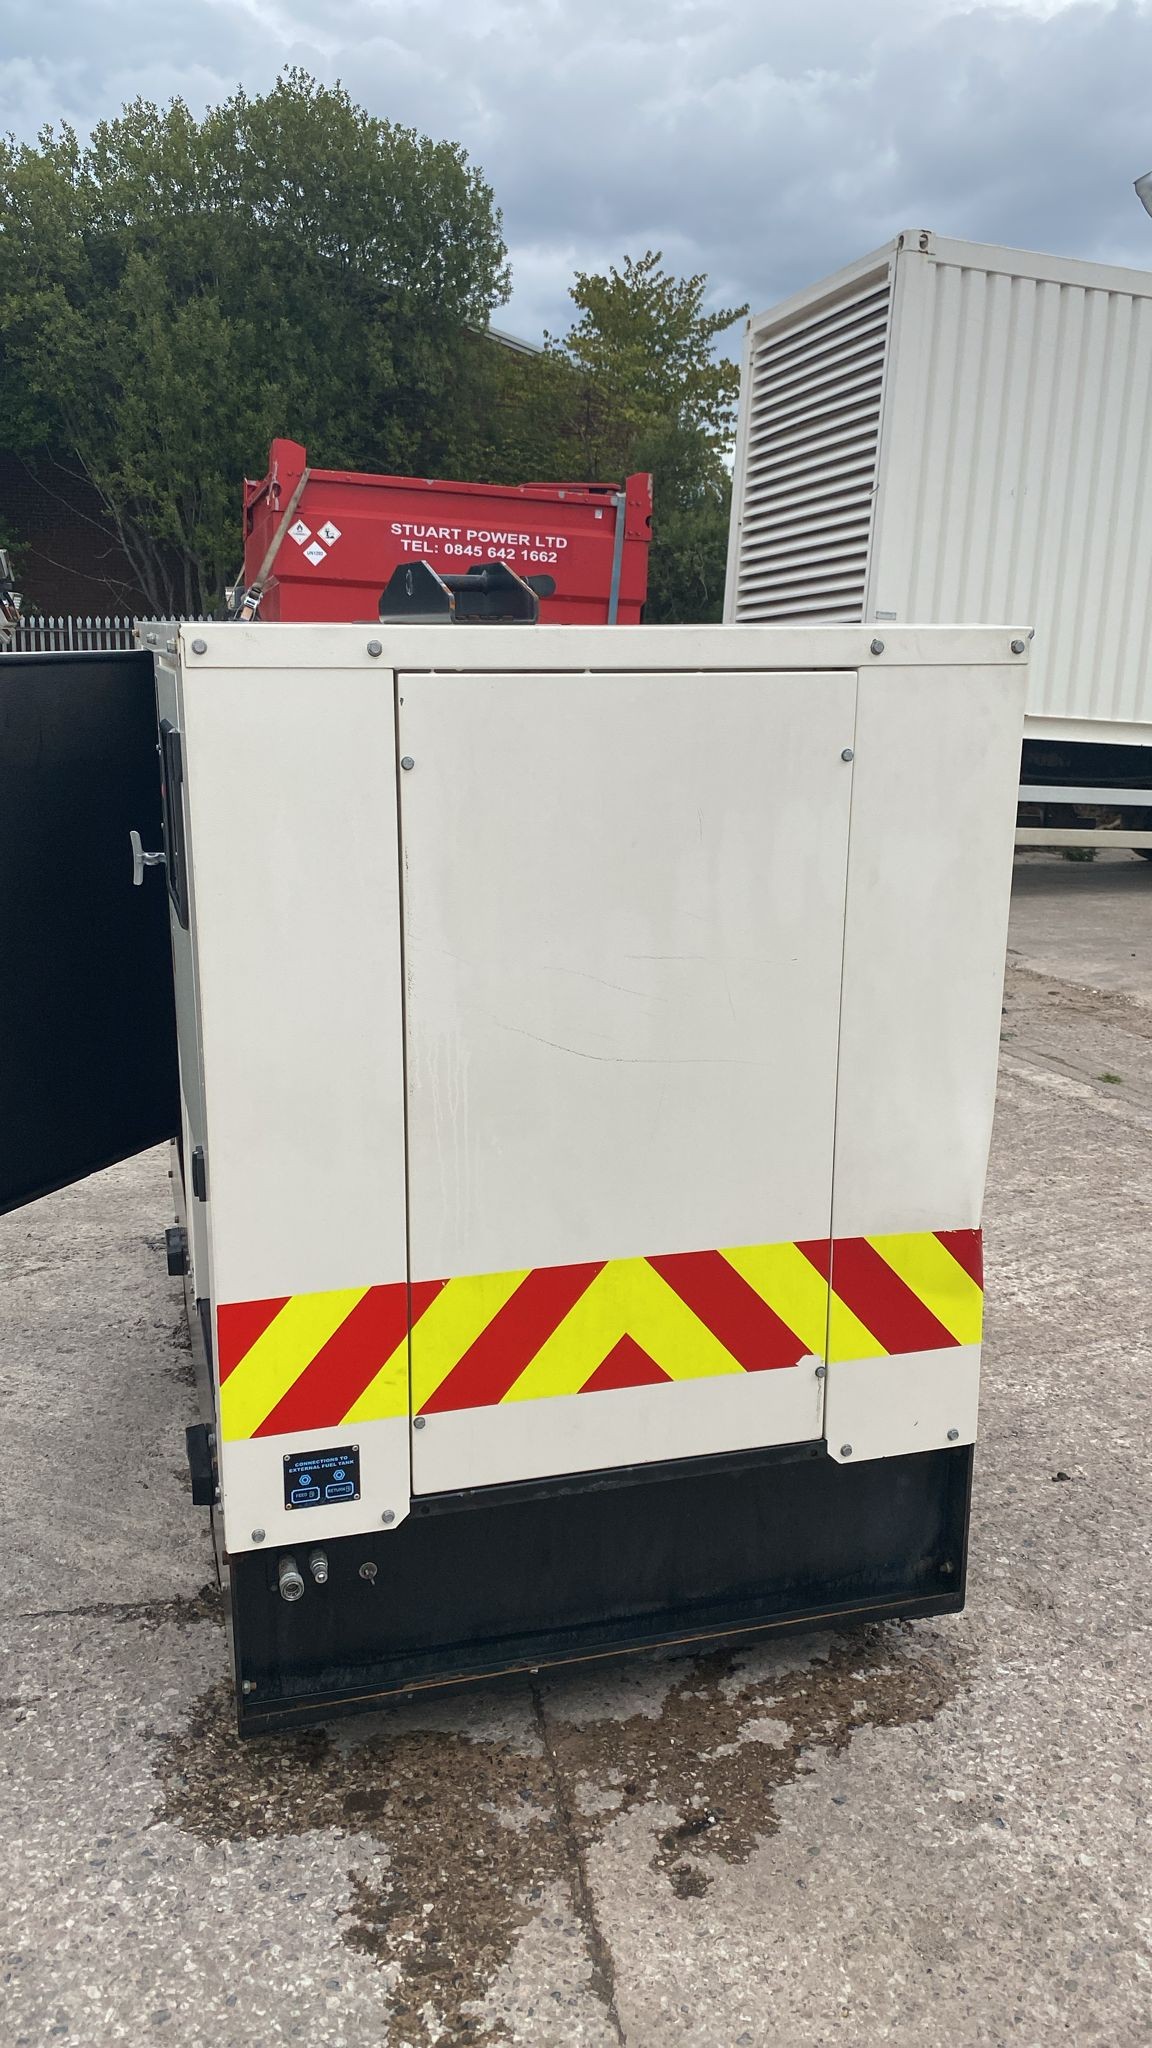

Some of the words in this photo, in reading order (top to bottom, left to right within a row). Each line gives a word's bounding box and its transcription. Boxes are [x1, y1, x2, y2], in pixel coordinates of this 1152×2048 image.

[391, 523, 461, 540] STUART
[466, 530, 530, 546] POWER
[535, 536, 568, 549] LTD
[401, 539, 438, 553] TEL:
[444, 543, 483, 557] 0845
[487, 547, 515, 560] 642
[521, 550, 557, 563] 1662
[288, 1465, 321, 1473] EXTERNAL
[295, 1457, 338, 1467] CONNECTIONS
